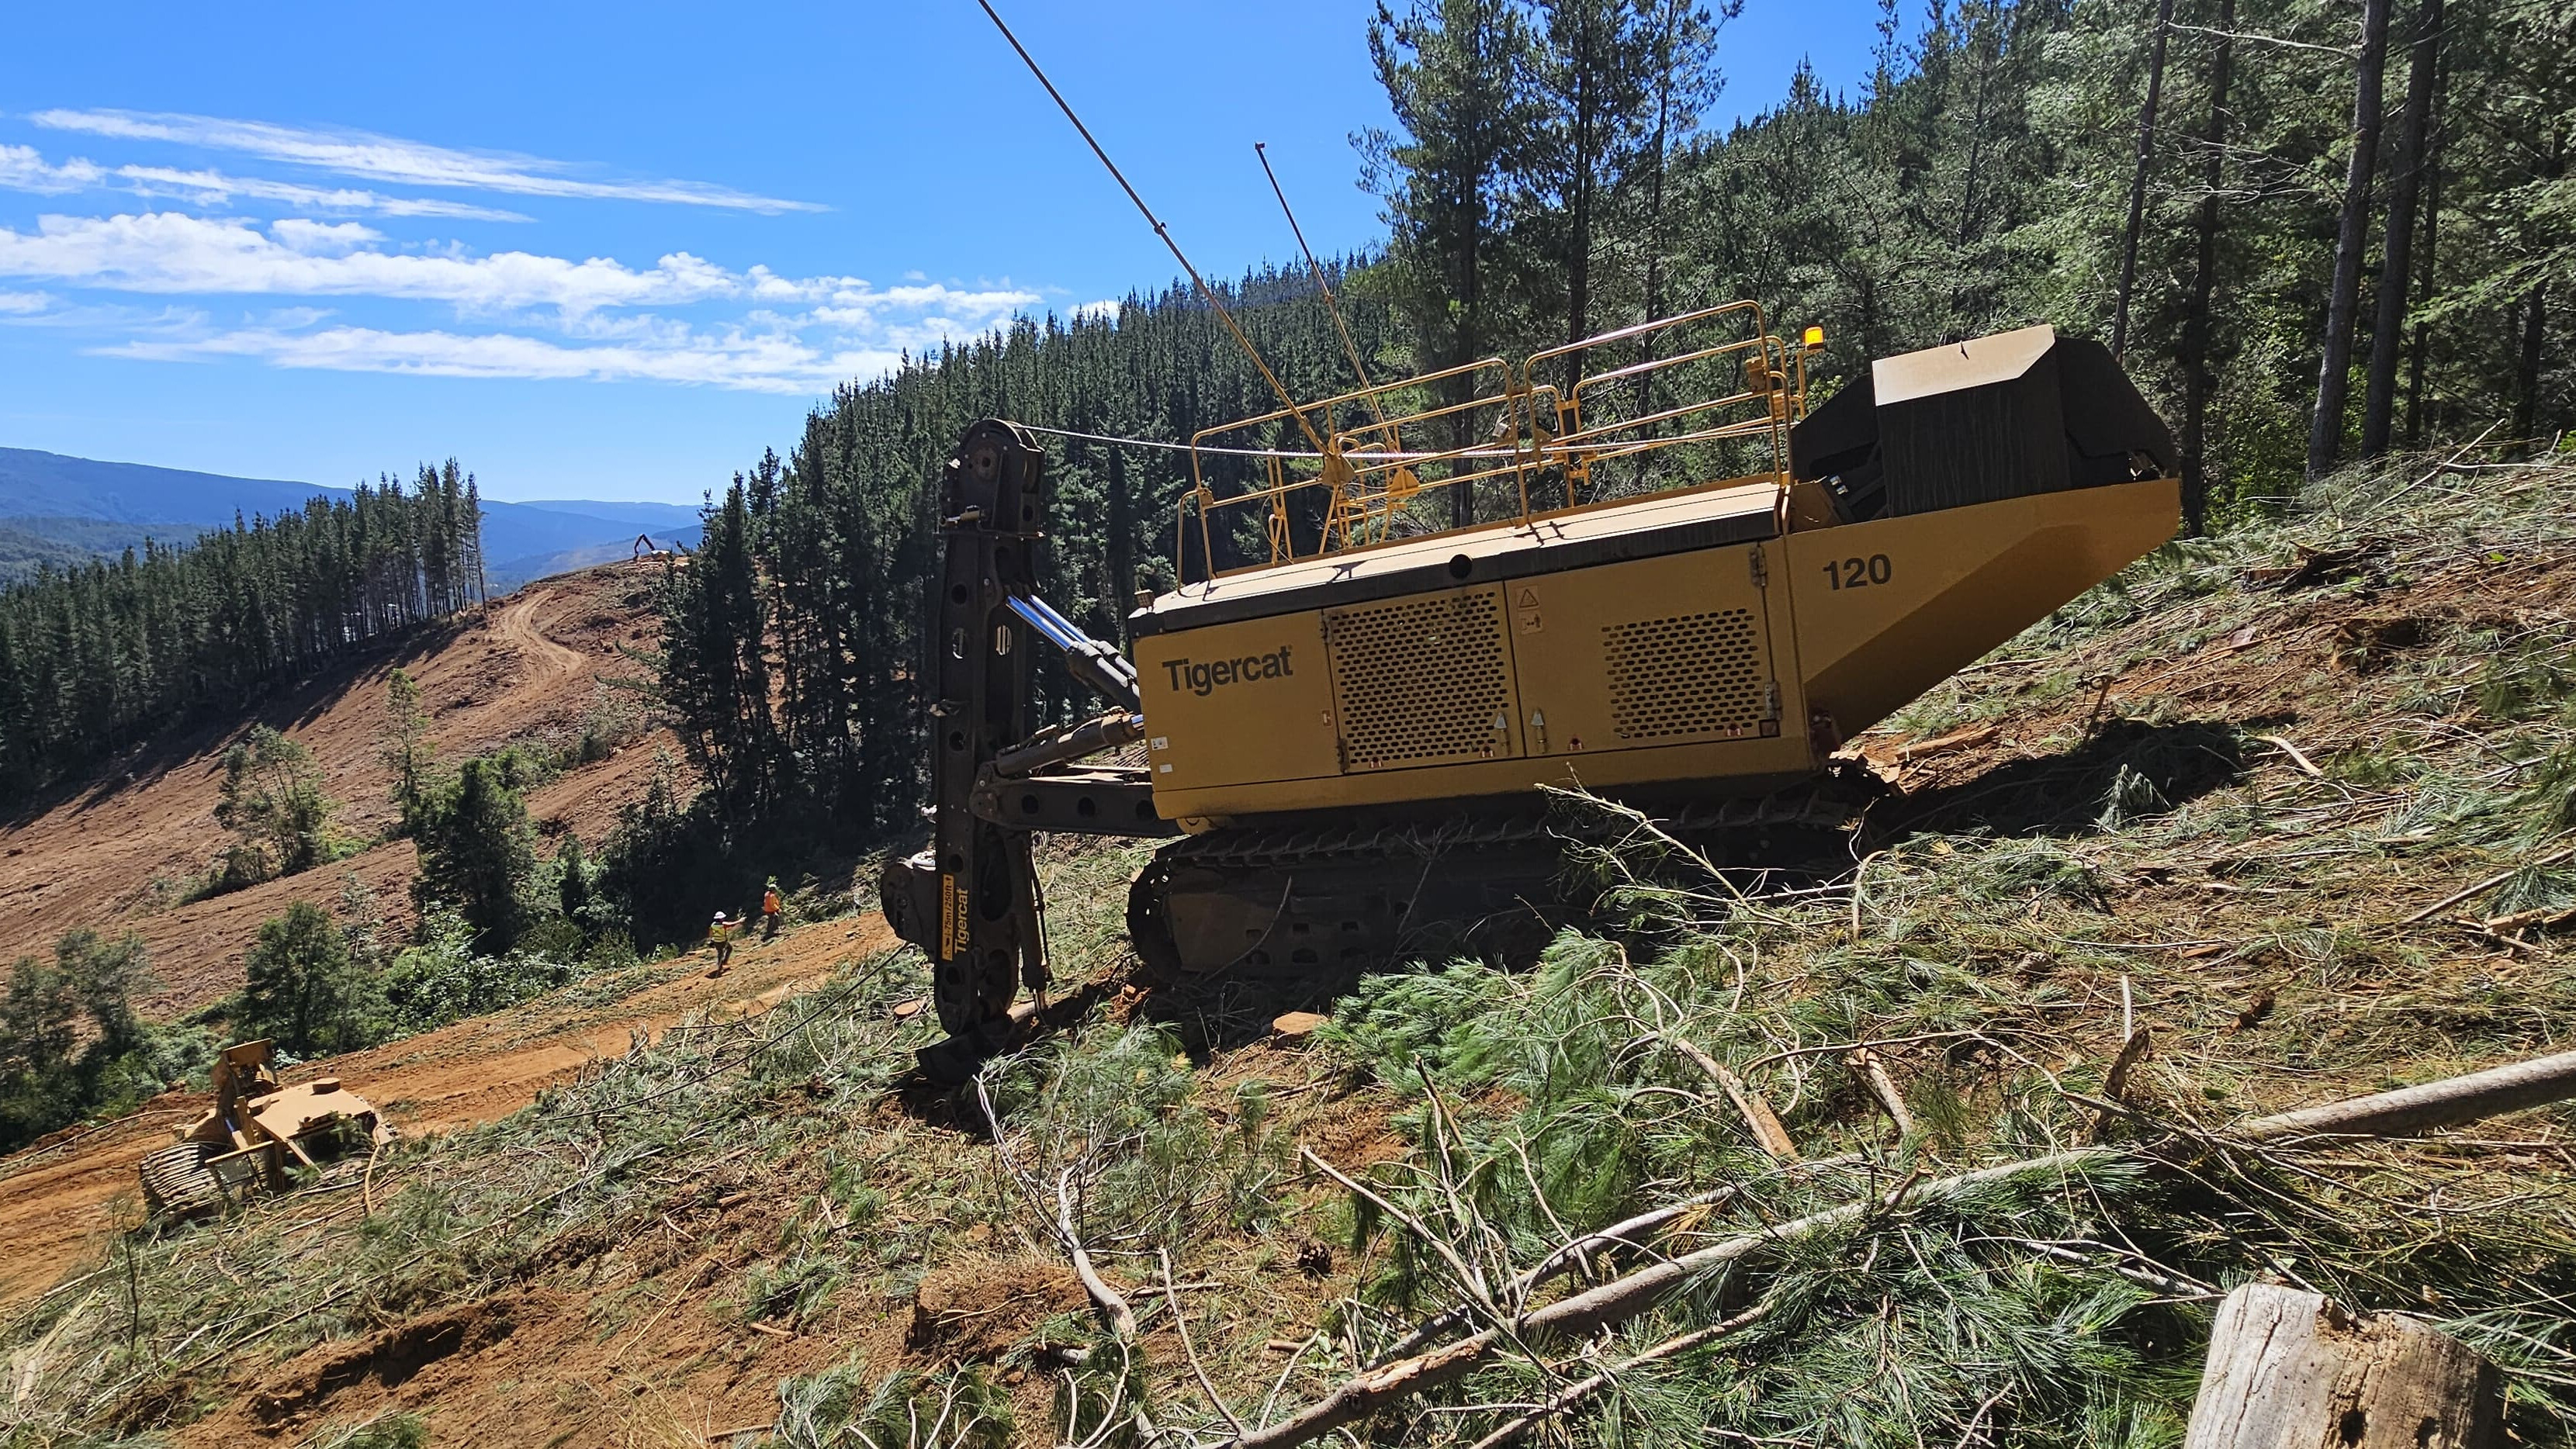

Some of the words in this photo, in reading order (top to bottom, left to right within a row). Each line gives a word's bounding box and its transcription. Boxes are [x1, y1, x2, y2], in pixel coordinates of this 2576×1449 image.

[1823, 554, 1892, 590] 120
[1162, 645, 1293, 697] Tigercat
[954, 887, 969, 954] Tigercat
